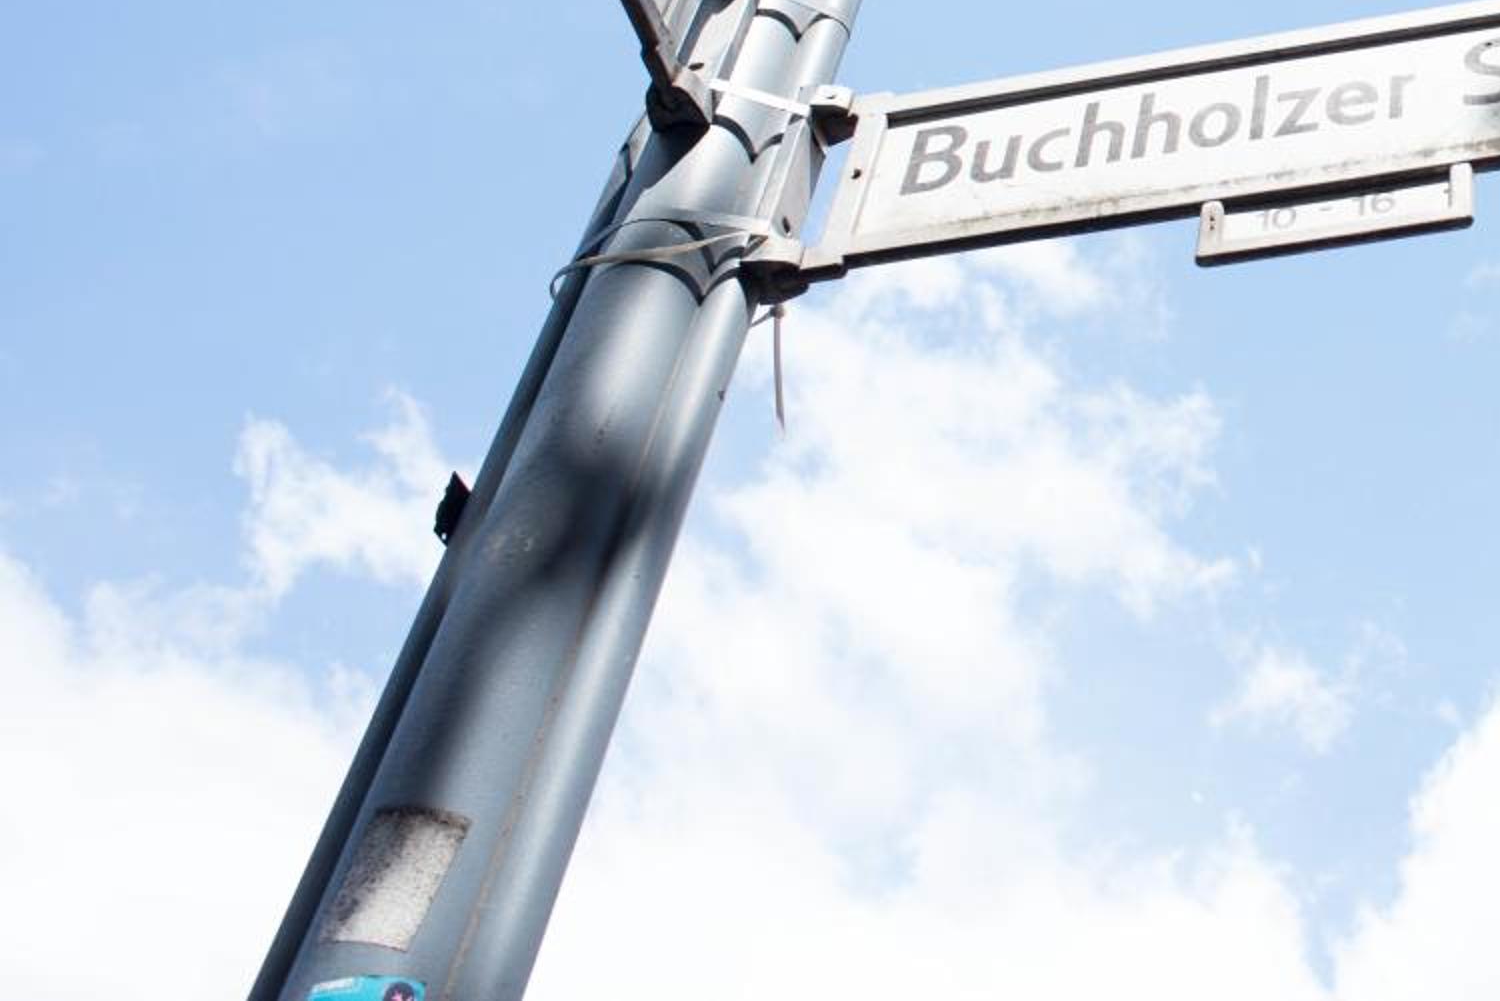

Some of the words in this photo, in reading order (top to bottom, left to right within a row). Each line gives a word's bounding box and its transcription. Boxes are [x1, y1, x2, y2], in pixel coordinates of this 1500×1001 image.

[899, 71, 1415, 196] Buchholzer
[1257, 207, 1297, 231] 10
[1352, 194, 1397, 216] 16
